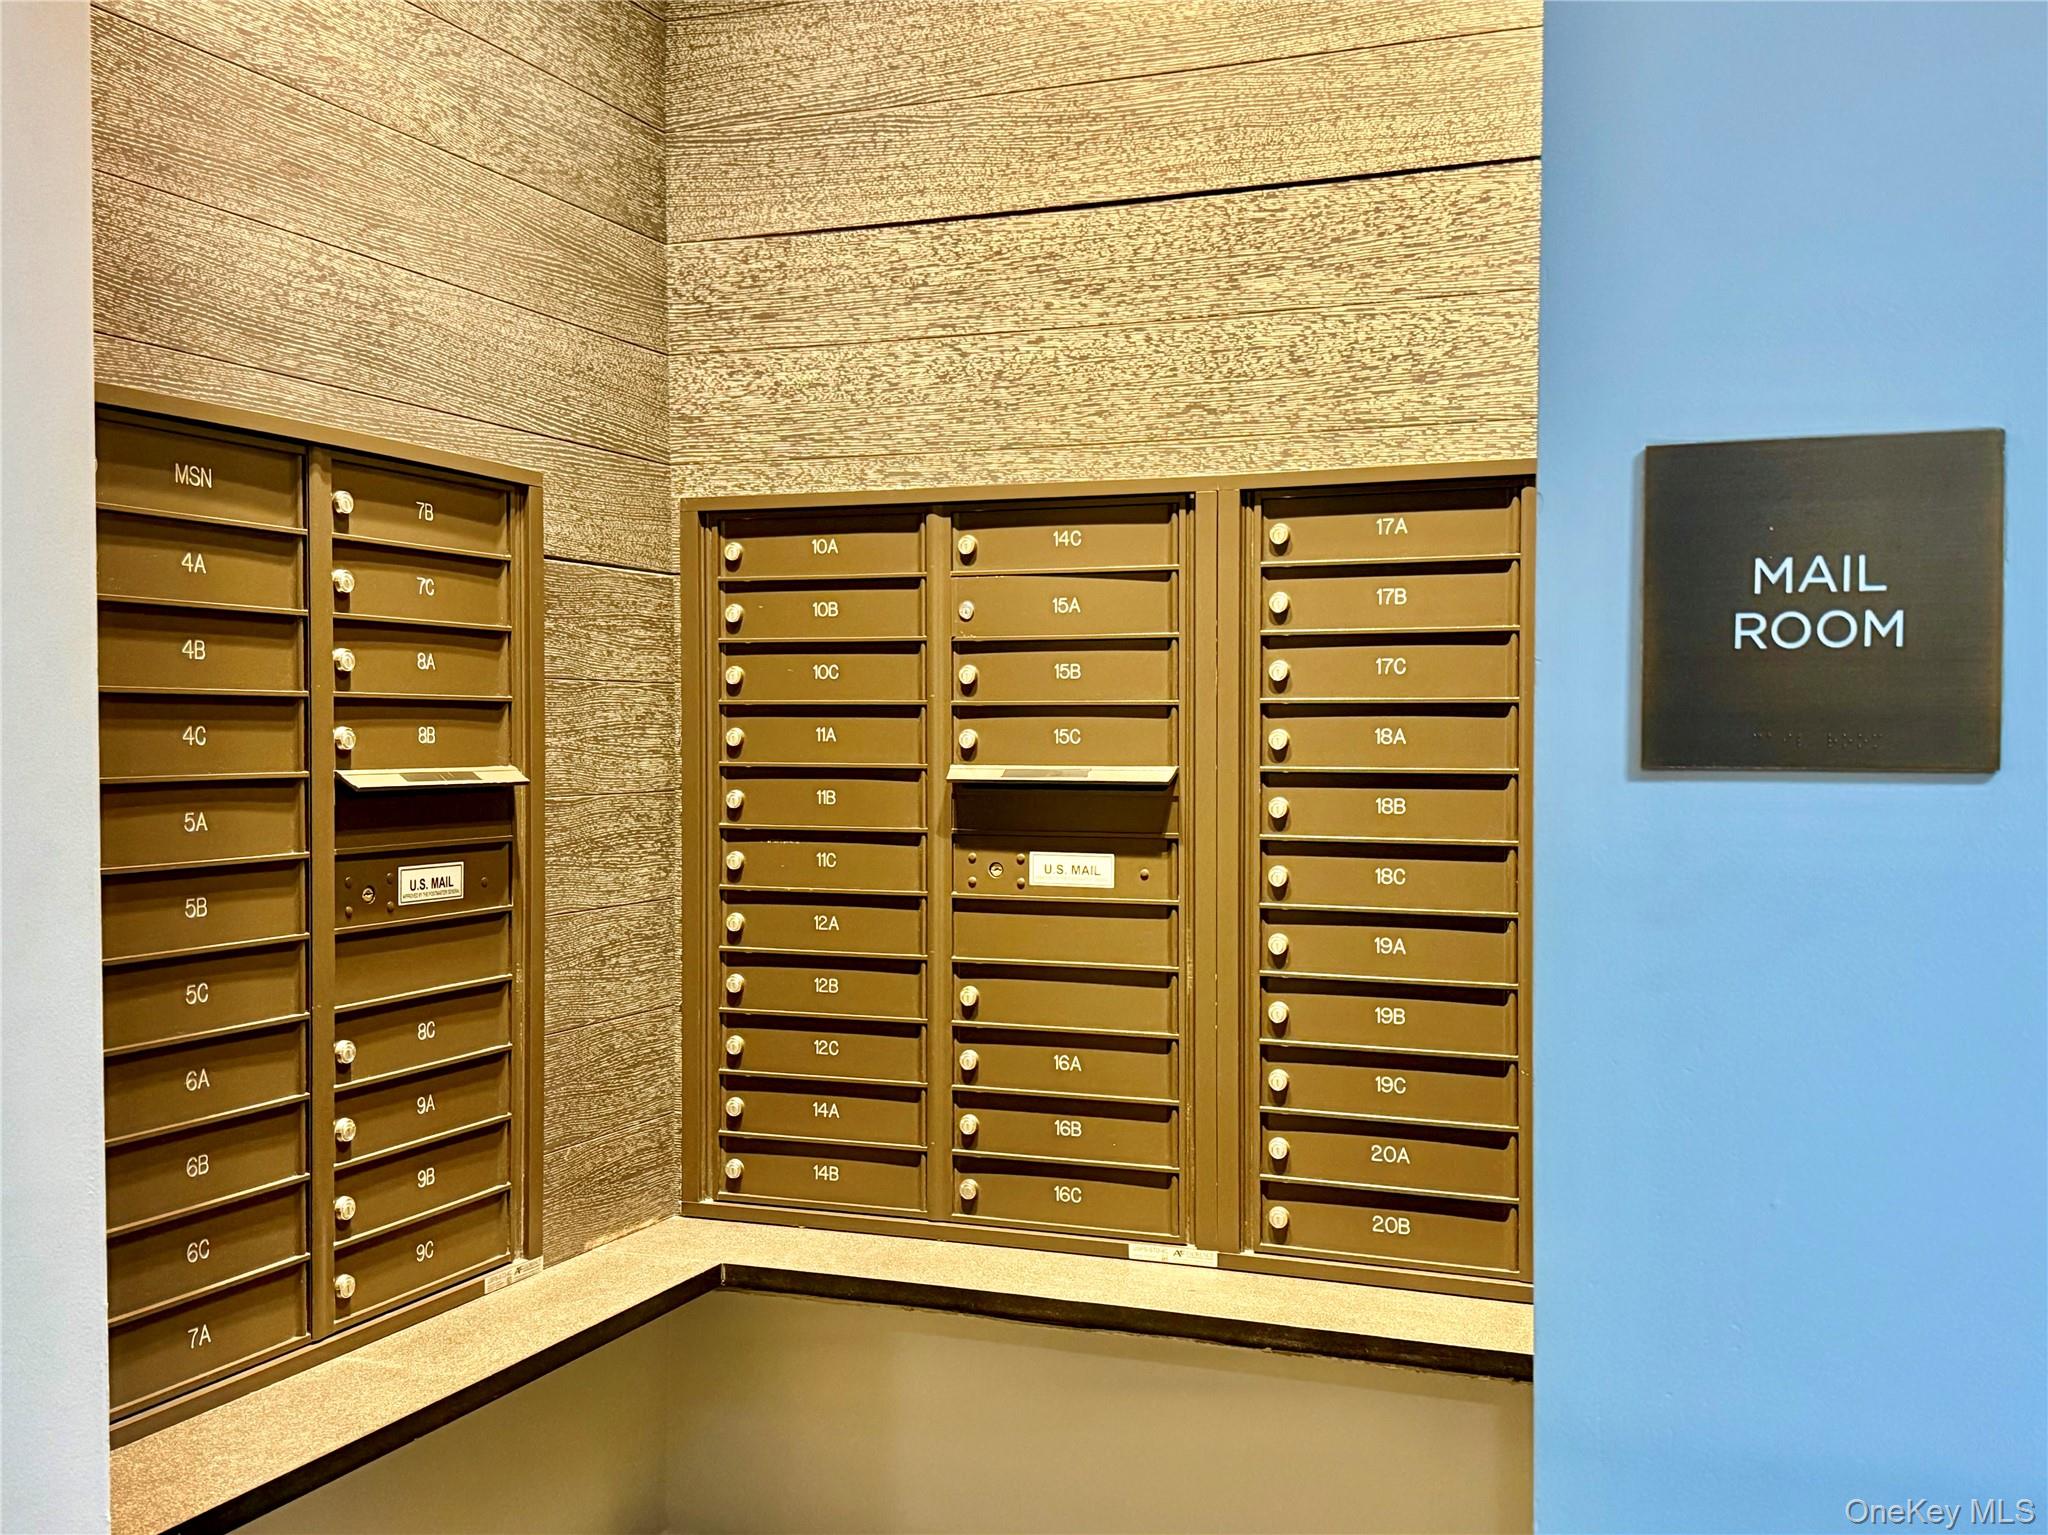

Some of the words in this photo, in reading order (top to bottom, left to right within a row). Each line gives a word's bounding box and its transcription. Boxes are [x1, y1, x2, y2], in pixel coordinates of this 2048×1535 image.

[175, 463, 213, 489] MSN
[415, 501, 434, 522] 7B
[1376, 517, 1408, 536] 17A
[811, 538, 839, 555] 10A
[1052, 529, 1082, 547] 14C
[181, 552, 207, 574] 4A
[1753, 554, 1888, 595] MAIL
[416, 576, 435, 597] 7C
[1052, 597, 1081, 614] 15A
[1376, 587, 1408, 606] 17B
[812, 601, 839, 617] 10B
[1733, 609, 1905, 650] ROOM
[181, 639, 206, 660] 4B
[417, 652, 436, 671] 8A
[1375, 657, 1407, 675] 17C
[812, 663, 840, 680] 10C
[1054, 663, 1082, 680] 15B
[182, 725, 207, 746] 4C
[417, 726, 436, 744] 8B
[815, 726, 837, 742] 11A
[1053, 728, 1081, 745] 15C
[1374, 727, 1407, 745] 18A
[816, 789, 837, 805] 11B
[1375, 797, 1407, 815] 18B
[183, 811, 209, 833] 5A
[816, 852, 837, 868] 11C
[1044, 863, 1067, 875] U.S.
[1071, 864, 1102, 876] MAIL
[409, 878, 429, 891] U.S.
[431, 875, 454, 889] MAIL
[1374, 867, 1406, 886] 18C
[184, 897, 208, 919] 5B
[813, 915, 840, 931] 12A
[1374, 936, 1407, 955] 19A
[185, 982, 209, 1005] 5C
[814, 977, 839, 994] 12B
[1374, 1006, 1406, 1025] 19B
[417, 1020, 436, 1041] 8C
[813, 1039, 839, 1056] 12C
[1053, 1054, 1082, 1072] 16A
[185, 1068, 211, 1092] 6A
[1375, 1075, 1407, 1095] 19C
[416, 1094, 436, 1115] 9A
[812, 1101, 840, 1119] 14A
[1054, 1119, 1082, 1137] 16B
[1371, 1144, 1411, 1165] 20A
[186, 1154, 210, 1178] 6B
[813, 1164, 839, 1182] 14B
[417, 1167, 436, 1188] 9B
[1053, 1185, 1082, 1204] 16C
[1372, 1215, 1411, 1235] 20B
[186, 1238, 210, 1263] 6C
[416, 1240, 434, 1263] 9C
[187, 1324, 212, 1349] 7A
